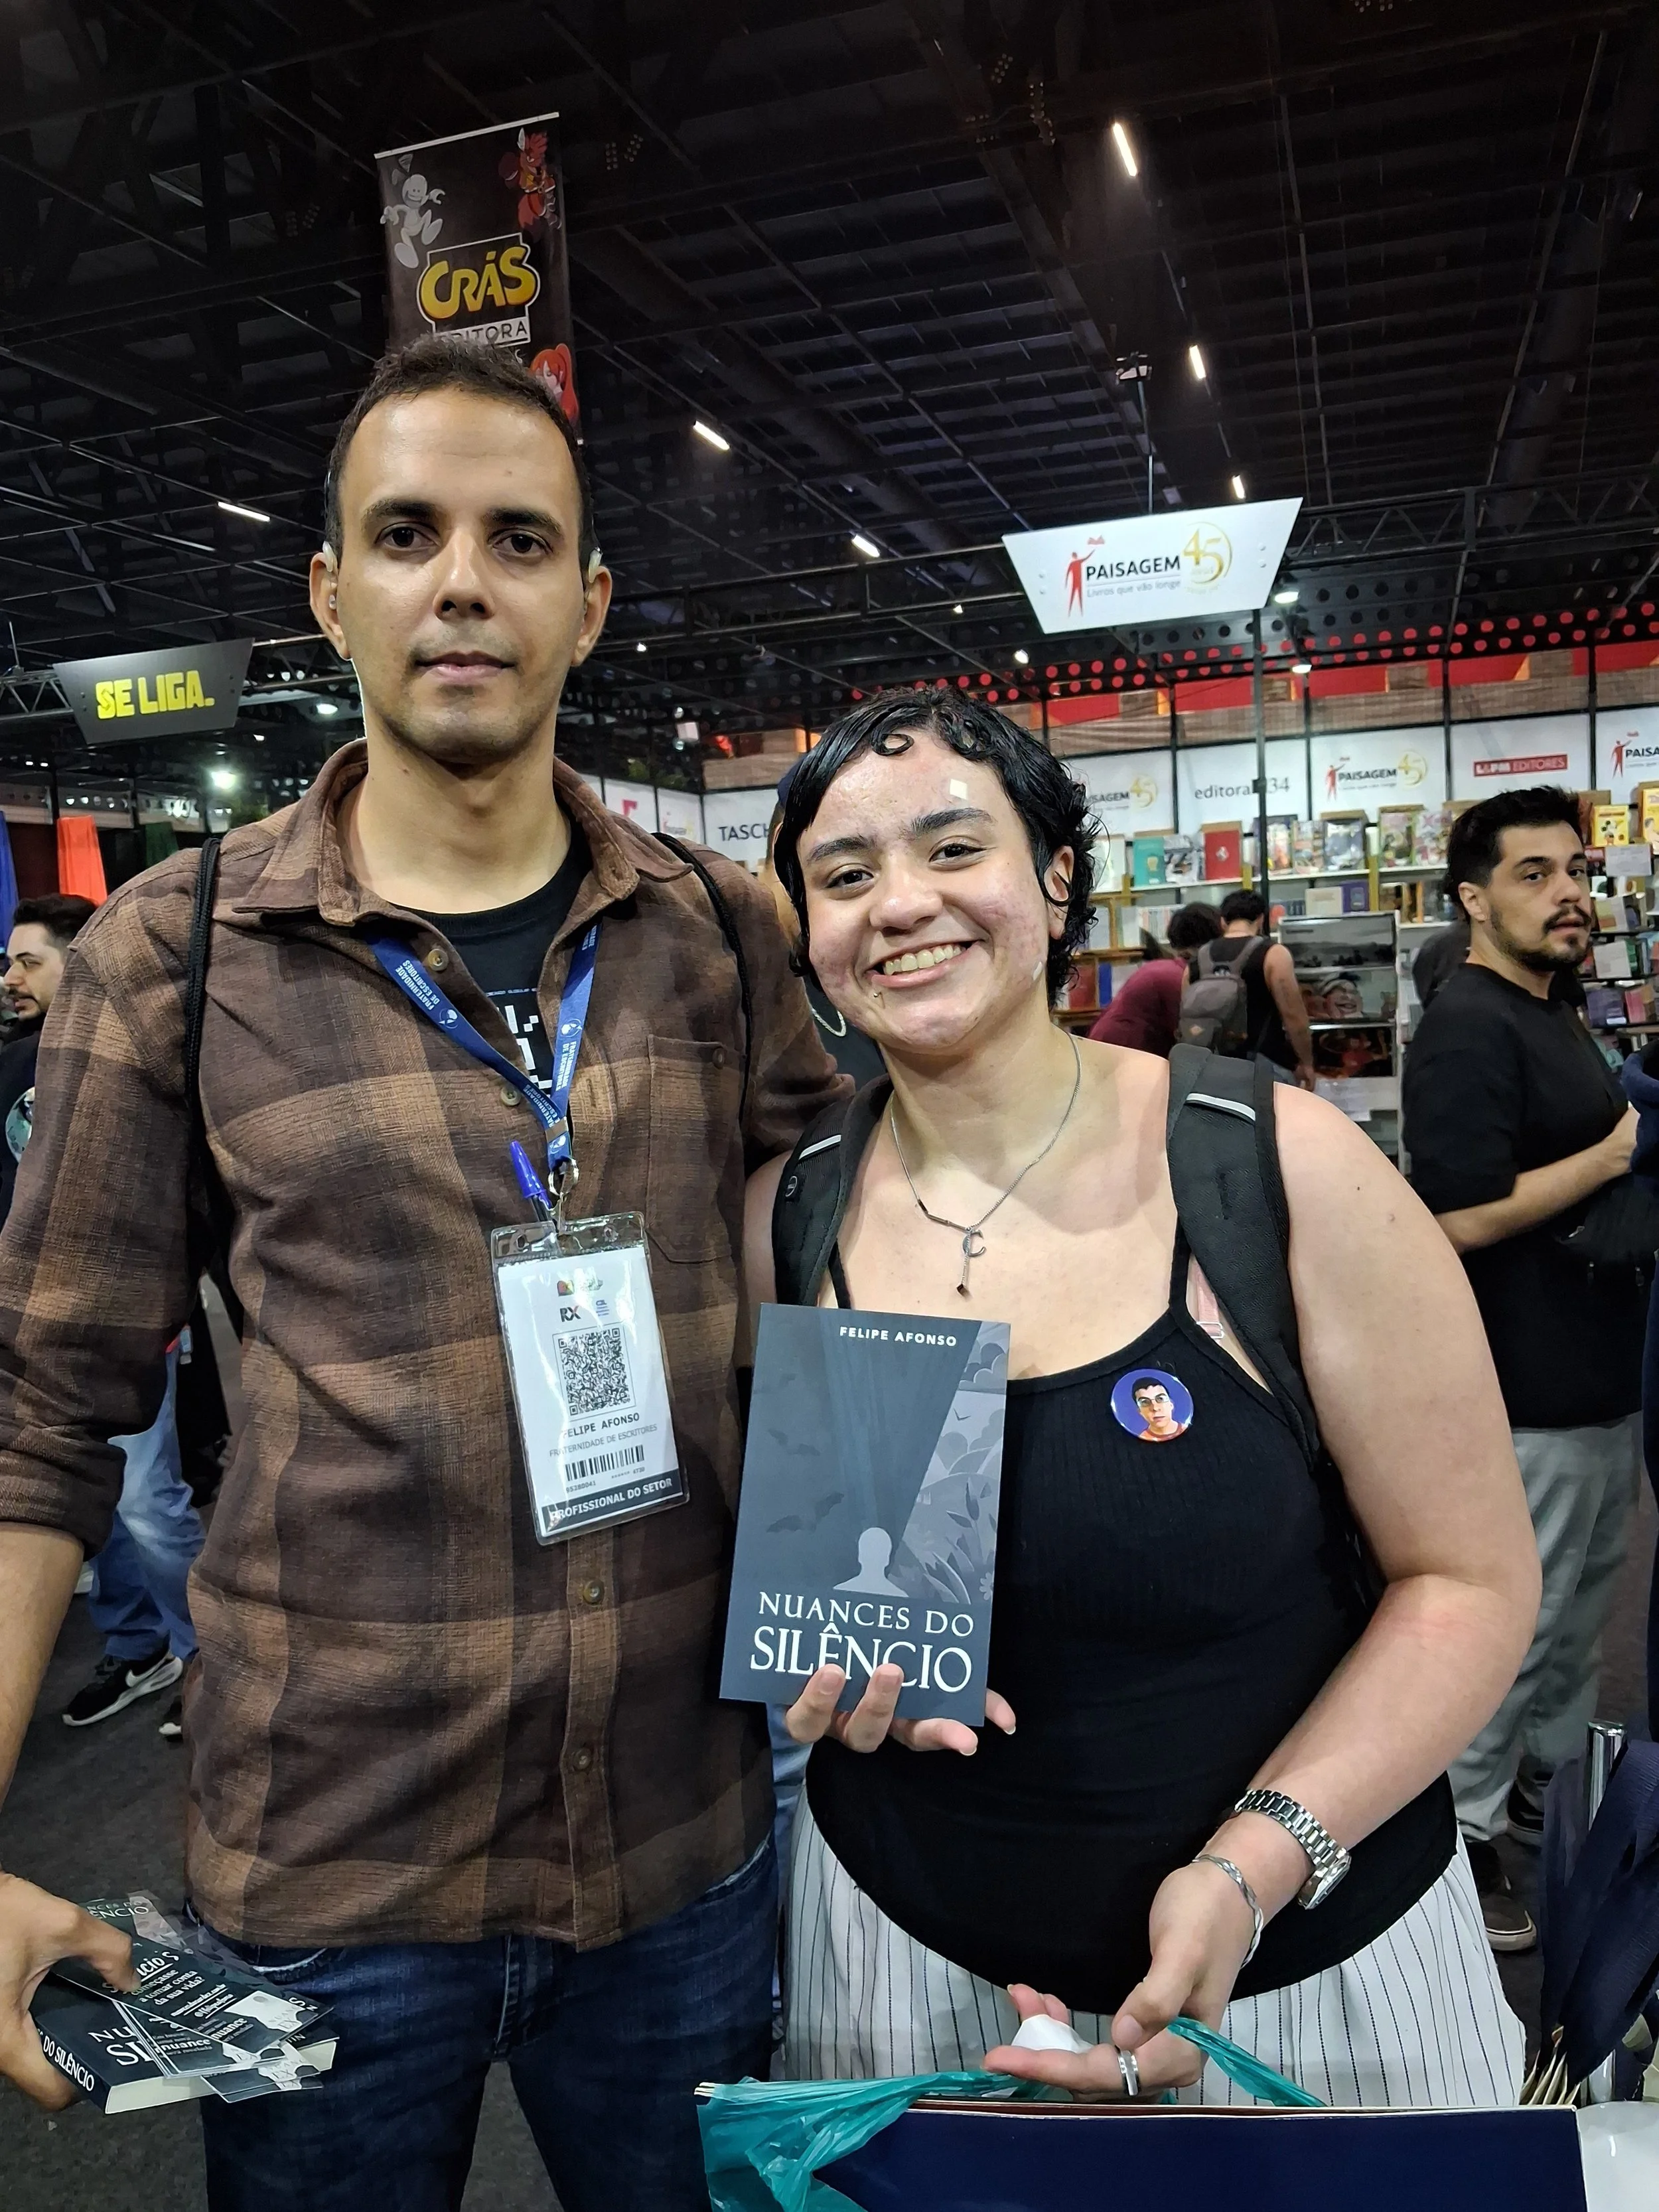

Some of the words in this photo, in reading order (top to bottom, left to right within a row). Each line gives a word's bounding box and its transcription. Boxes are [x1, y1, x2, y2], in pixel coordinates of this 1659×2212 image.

[421, 246, 536, 319] CRÁS
[1086, 555, 1181, 581] PAISAGEM
[1183, 528, 1224, 584] 45
[1117, 585, 1133, 596] que
[96, 679, 135, 719] SE
[138, 670, 215, 714] LIGA.
[1338, 769, 1397, 781] PAISAGEM
[1194, 785, 1250, 799] editora
[396, 966, 435, 1010] FRATERNIDADE
[402, 960, 433, 996] ESCRITORES
[430, 994, 440, 1005] DE
[523, 1085, 555, 1128] RATERNIDADE
[559, 1305, 581, 1322] RX
[839, 1326, 889, 1341] FELIPE
[895, 1331, 957, 1347] AFONSO
[601, 1412, 640, 1429] AFONSO
[607, 1435, 616, 1443] DE
[618, 1424, 658, 1440] ESCRITORES
[550, 1493, 625, 1520] PROFISSIONAL
[627, 1488, 641, 1499] DO
[643, 1478, 672, 1494] SETOR
[758, 1591, 910, 1630] NUANCES
[924, 1609, 974, 1637] DO
[750, 1622, 972, 1692] SILÊNCIO
[147, 1985, 173, 1999] tomar
[172, 1970, 198, 1985] conta
[167, 1990, 184, 2000] sua
[181, 1976, 206, 1991] vida?
[210, 2018, 248, 2040] nuance
[161, 2039, 211, 2051] nuance
[43, 2035, 55, 2057] DO
[54, 2046, 95, 2091] SILÊNCIO
